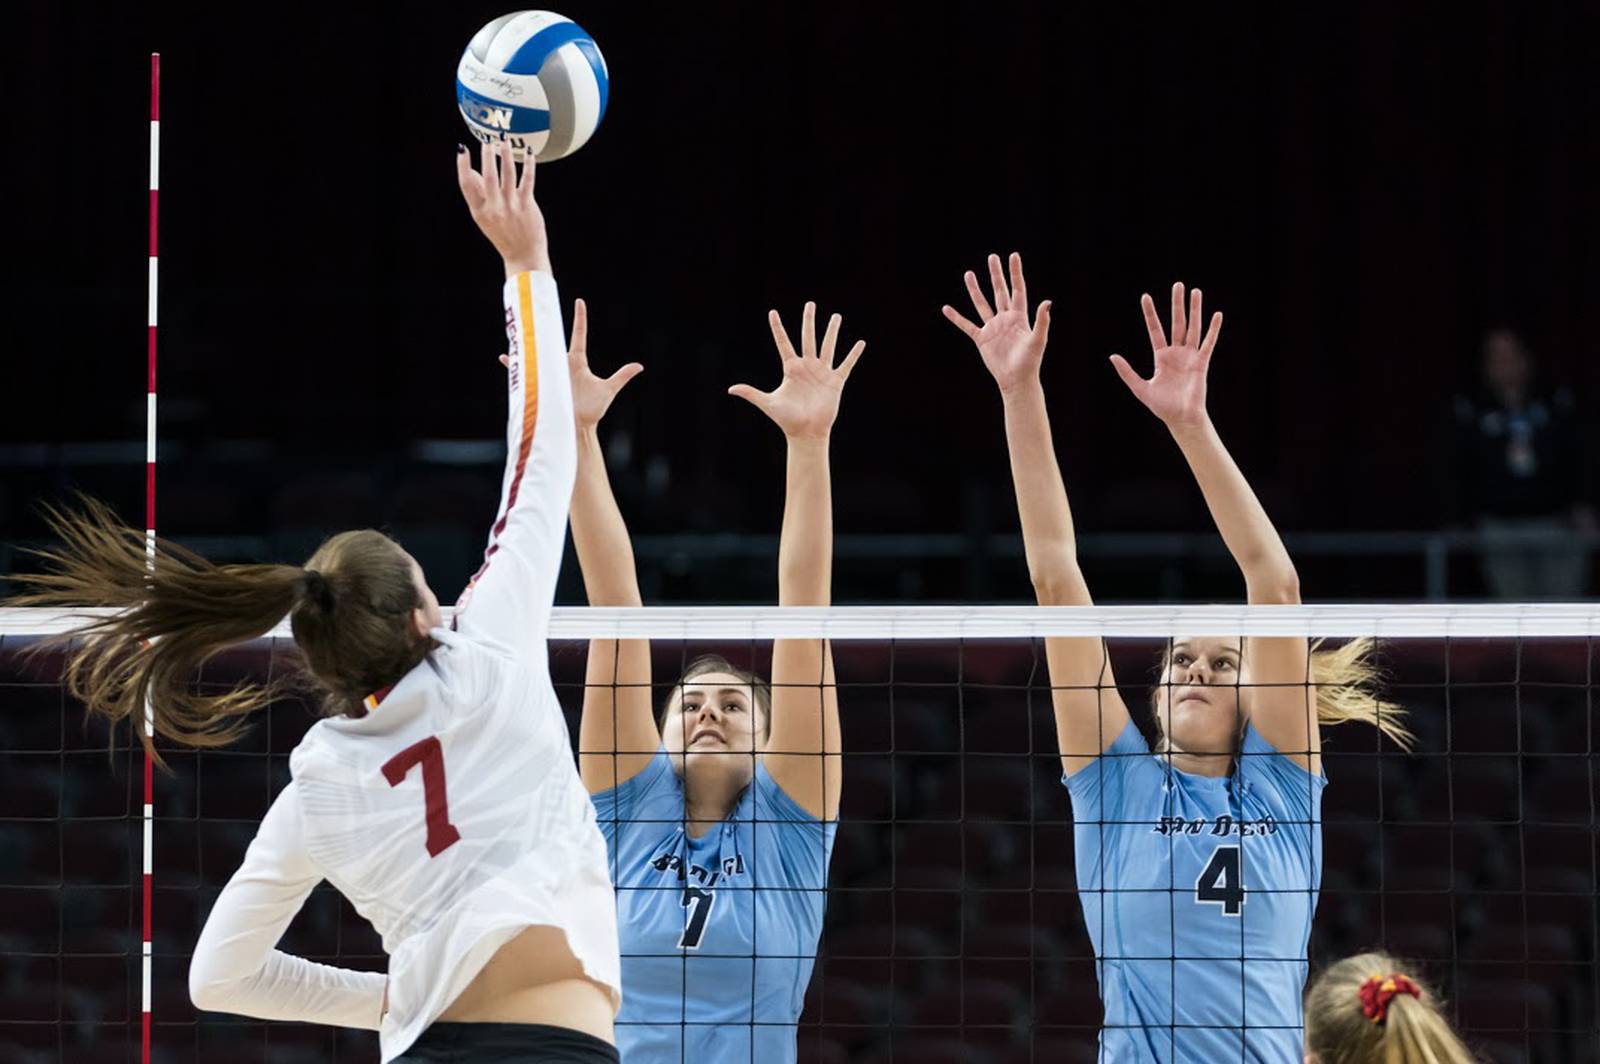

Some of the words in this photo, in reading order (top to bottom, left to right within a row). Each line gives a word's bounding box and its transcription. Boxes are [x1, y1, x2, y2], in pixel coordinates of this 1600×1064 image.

[380, 735, 462, 858] 7
[676, 884, 717, 950] 7
[1195, 844, 1247, 917] 4
